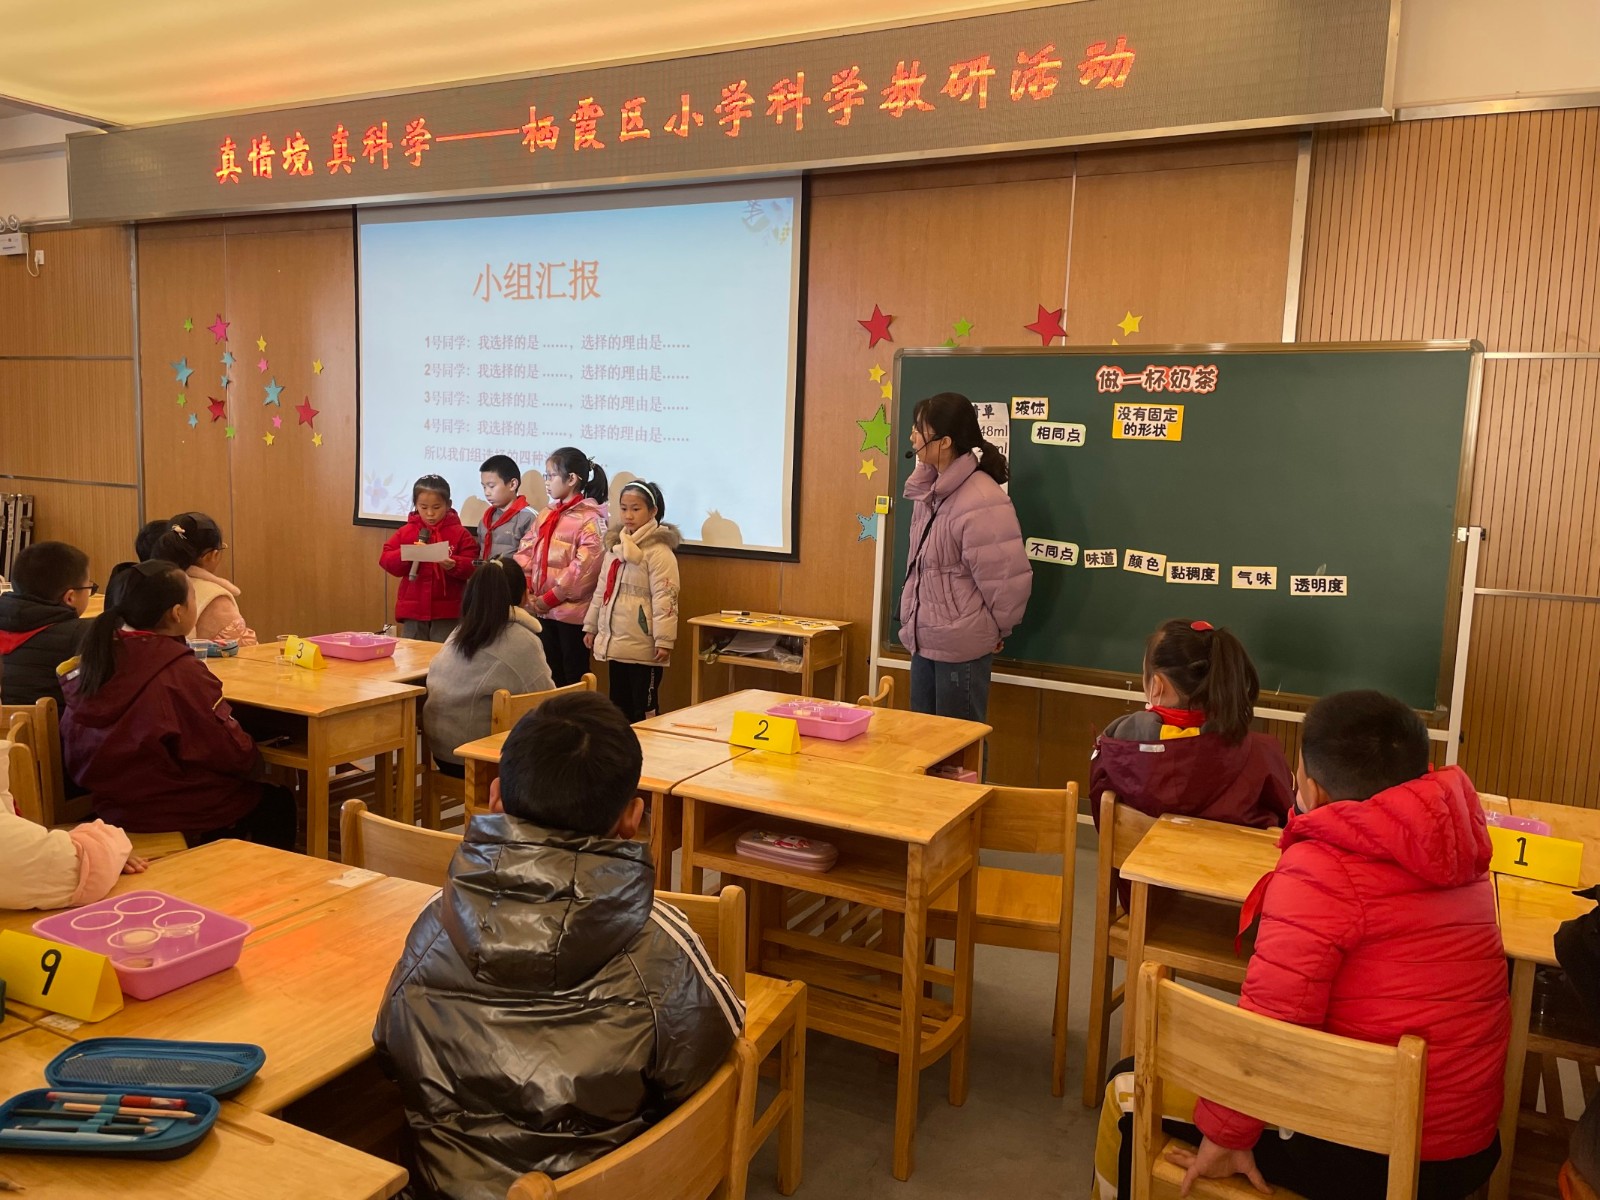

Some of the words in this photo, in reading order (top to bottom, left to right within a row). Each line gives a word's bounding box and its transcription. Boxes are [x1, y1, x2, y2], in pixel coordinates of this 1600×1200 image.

[472, 259, 602, 303] 小组汇报
[1099, 369, 1216, 390] 做一杯奶茶
[973, 403, 995, 419] 单
[1015, 400, 1045, 416] 液体
[1117, 406, 1179, 424] 没有固定
[1036, 426, 1081, 444] 相同点
[1123, 422, 1168, 438] 的形状
[1031, 541, 1074, 562] 不同点
[1085, 550, 1115, 567] 味道
[1127, 553, 1160, 572] 颜色
[1237, 570, 1272, 586] 气味
[1294, 577, 1344, 594] 透明度
[296, 642, 305, 659] 3
[753, 719, 770, 741] 2
[1513, 836, 1529, 867] 1
[40, 948, 62, 996] 9
